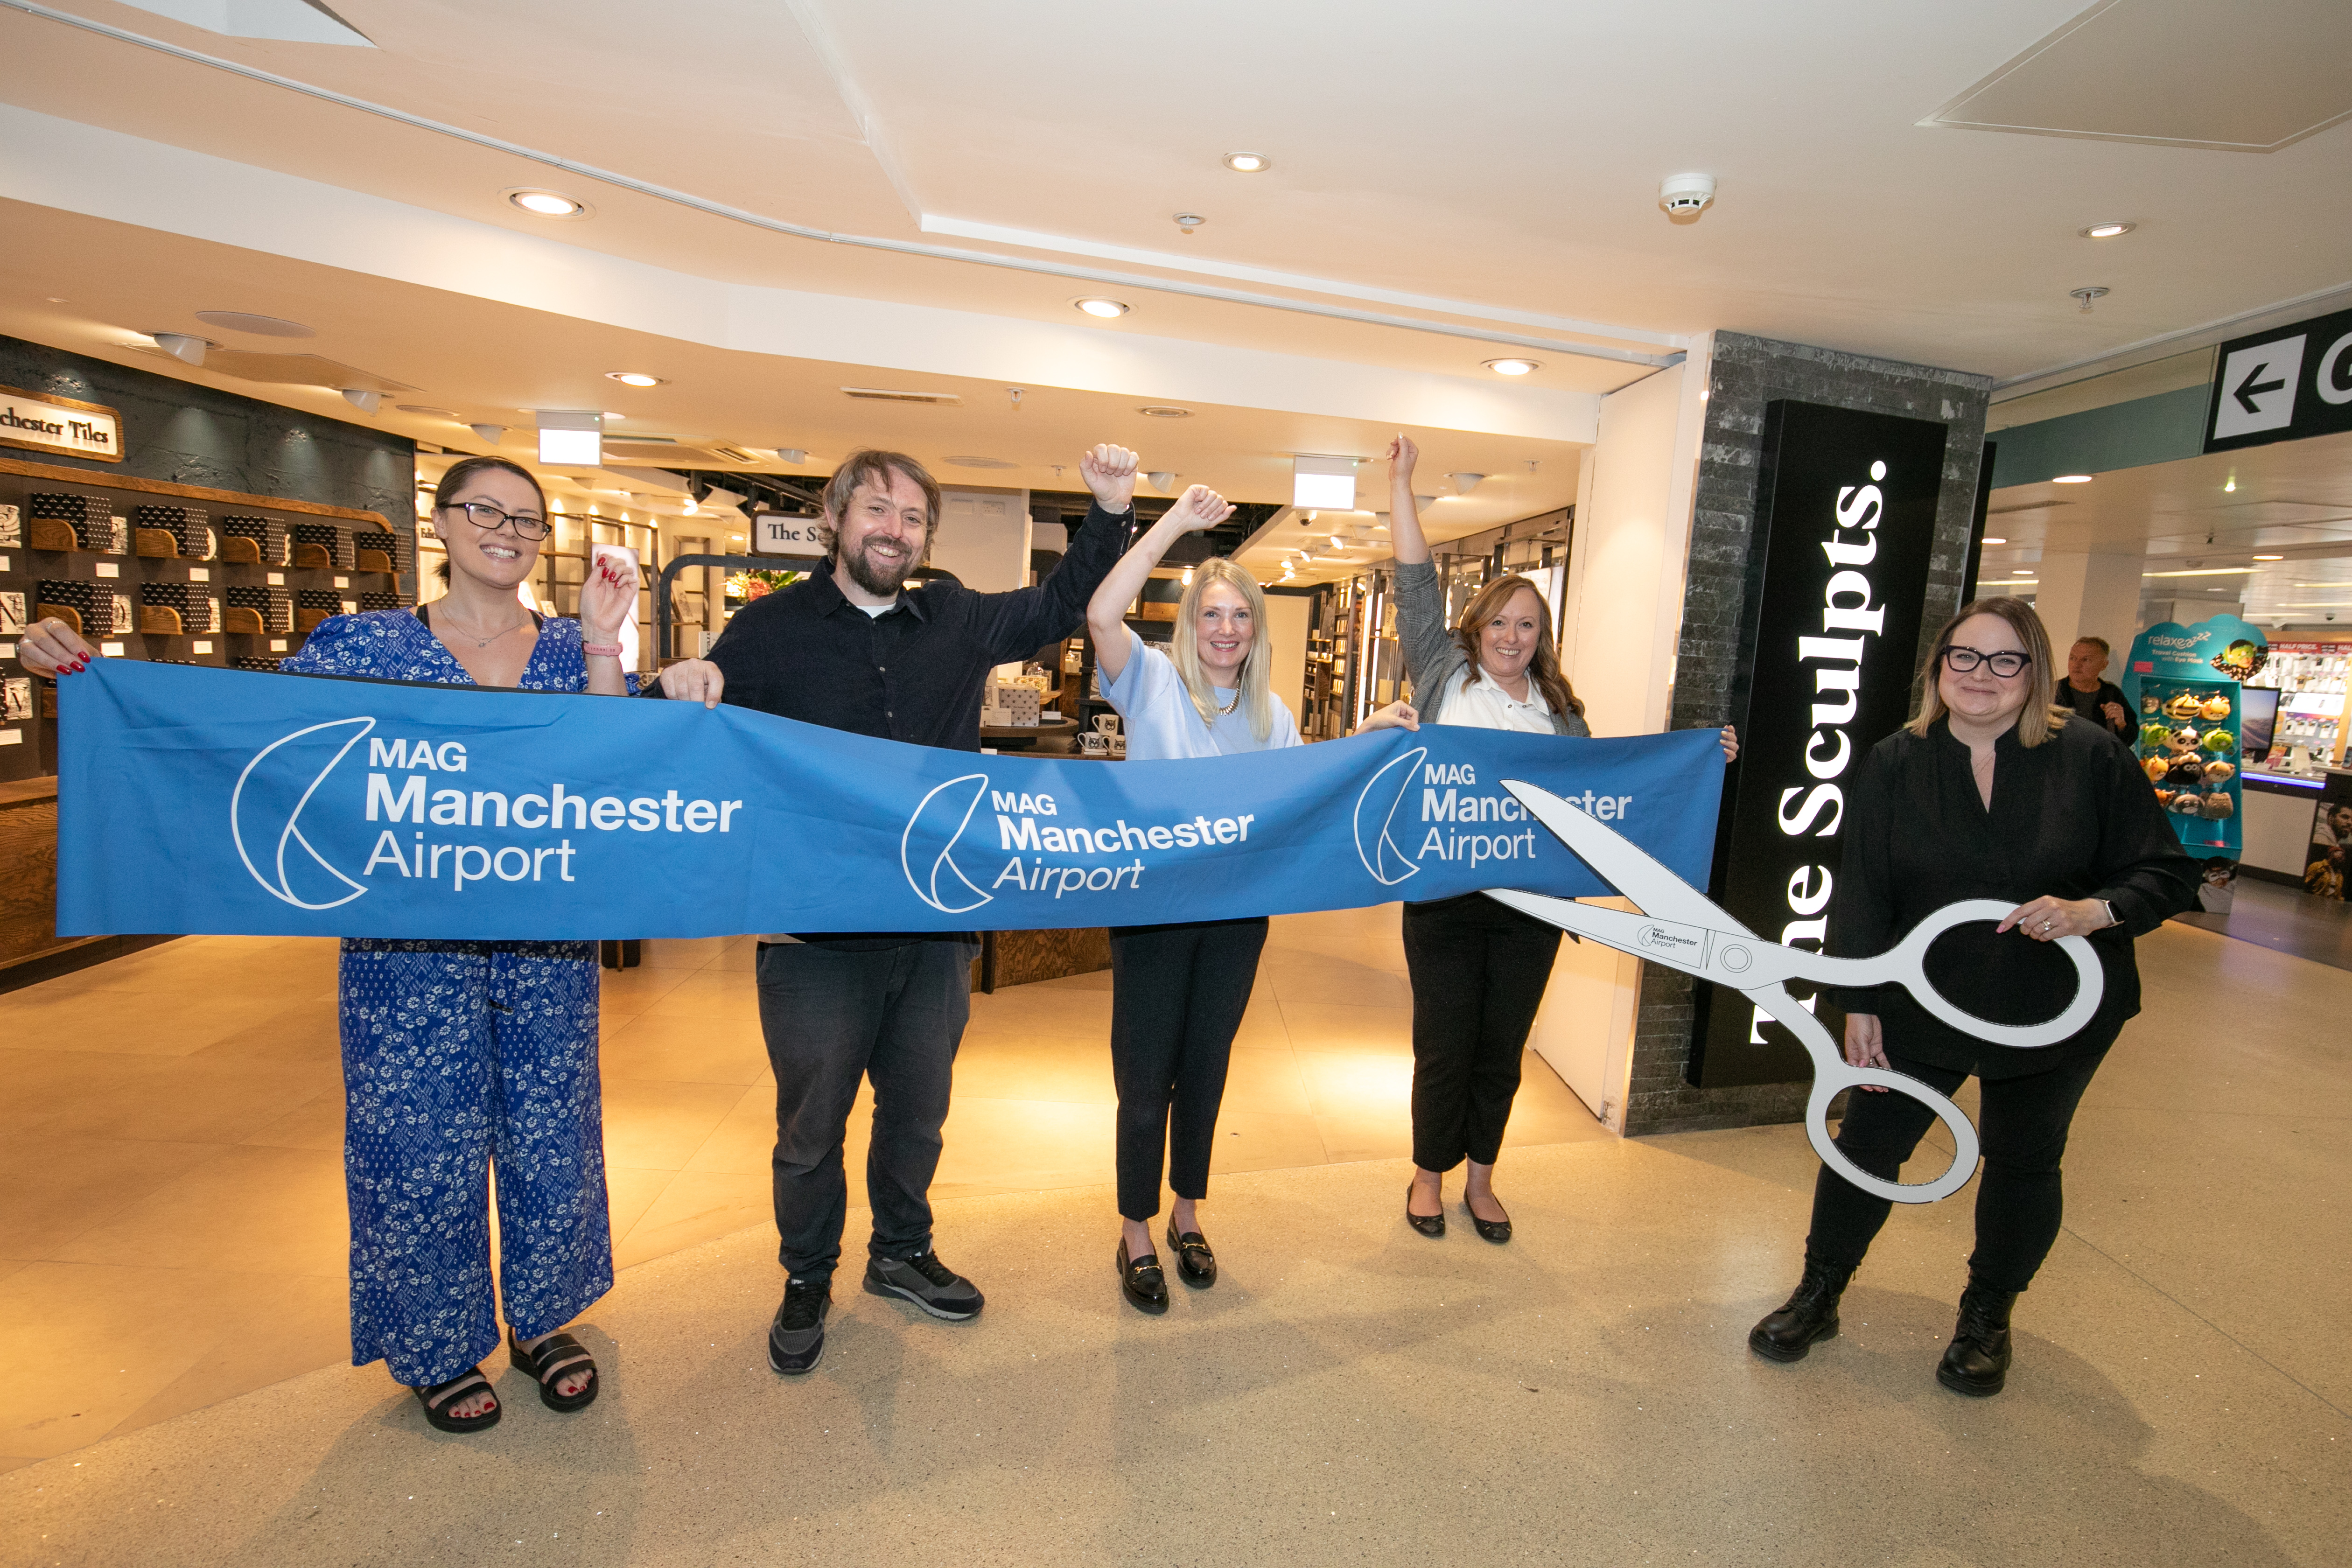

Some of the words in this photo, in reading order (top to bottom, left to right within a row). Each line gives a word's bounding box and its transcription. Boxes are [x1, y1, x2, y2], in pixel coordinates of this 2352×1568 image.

[68, 420, 108, 443] Tiles
[768, 523, 800, 540] The
[1778, 460, 1886, 837] Sculpts.
[370, 738, 466, 771] MAG
[1424, 764, 1476, 784] MAG
[366, 773, 742, 833] Manchester
[992, 791, 1057, 815] MAG
[1421, 789, 1632, 822] Mancter
[997, 815, 1254, 853] Manchester
[1417, 827, 1535, 868] Airport
[363, 830, 576, 891] Airport
[992, 857, 1145, 899] Airport
[1651, 938, 1675, 948] Airport
[1652, 932, 1697, 946] Manchester
